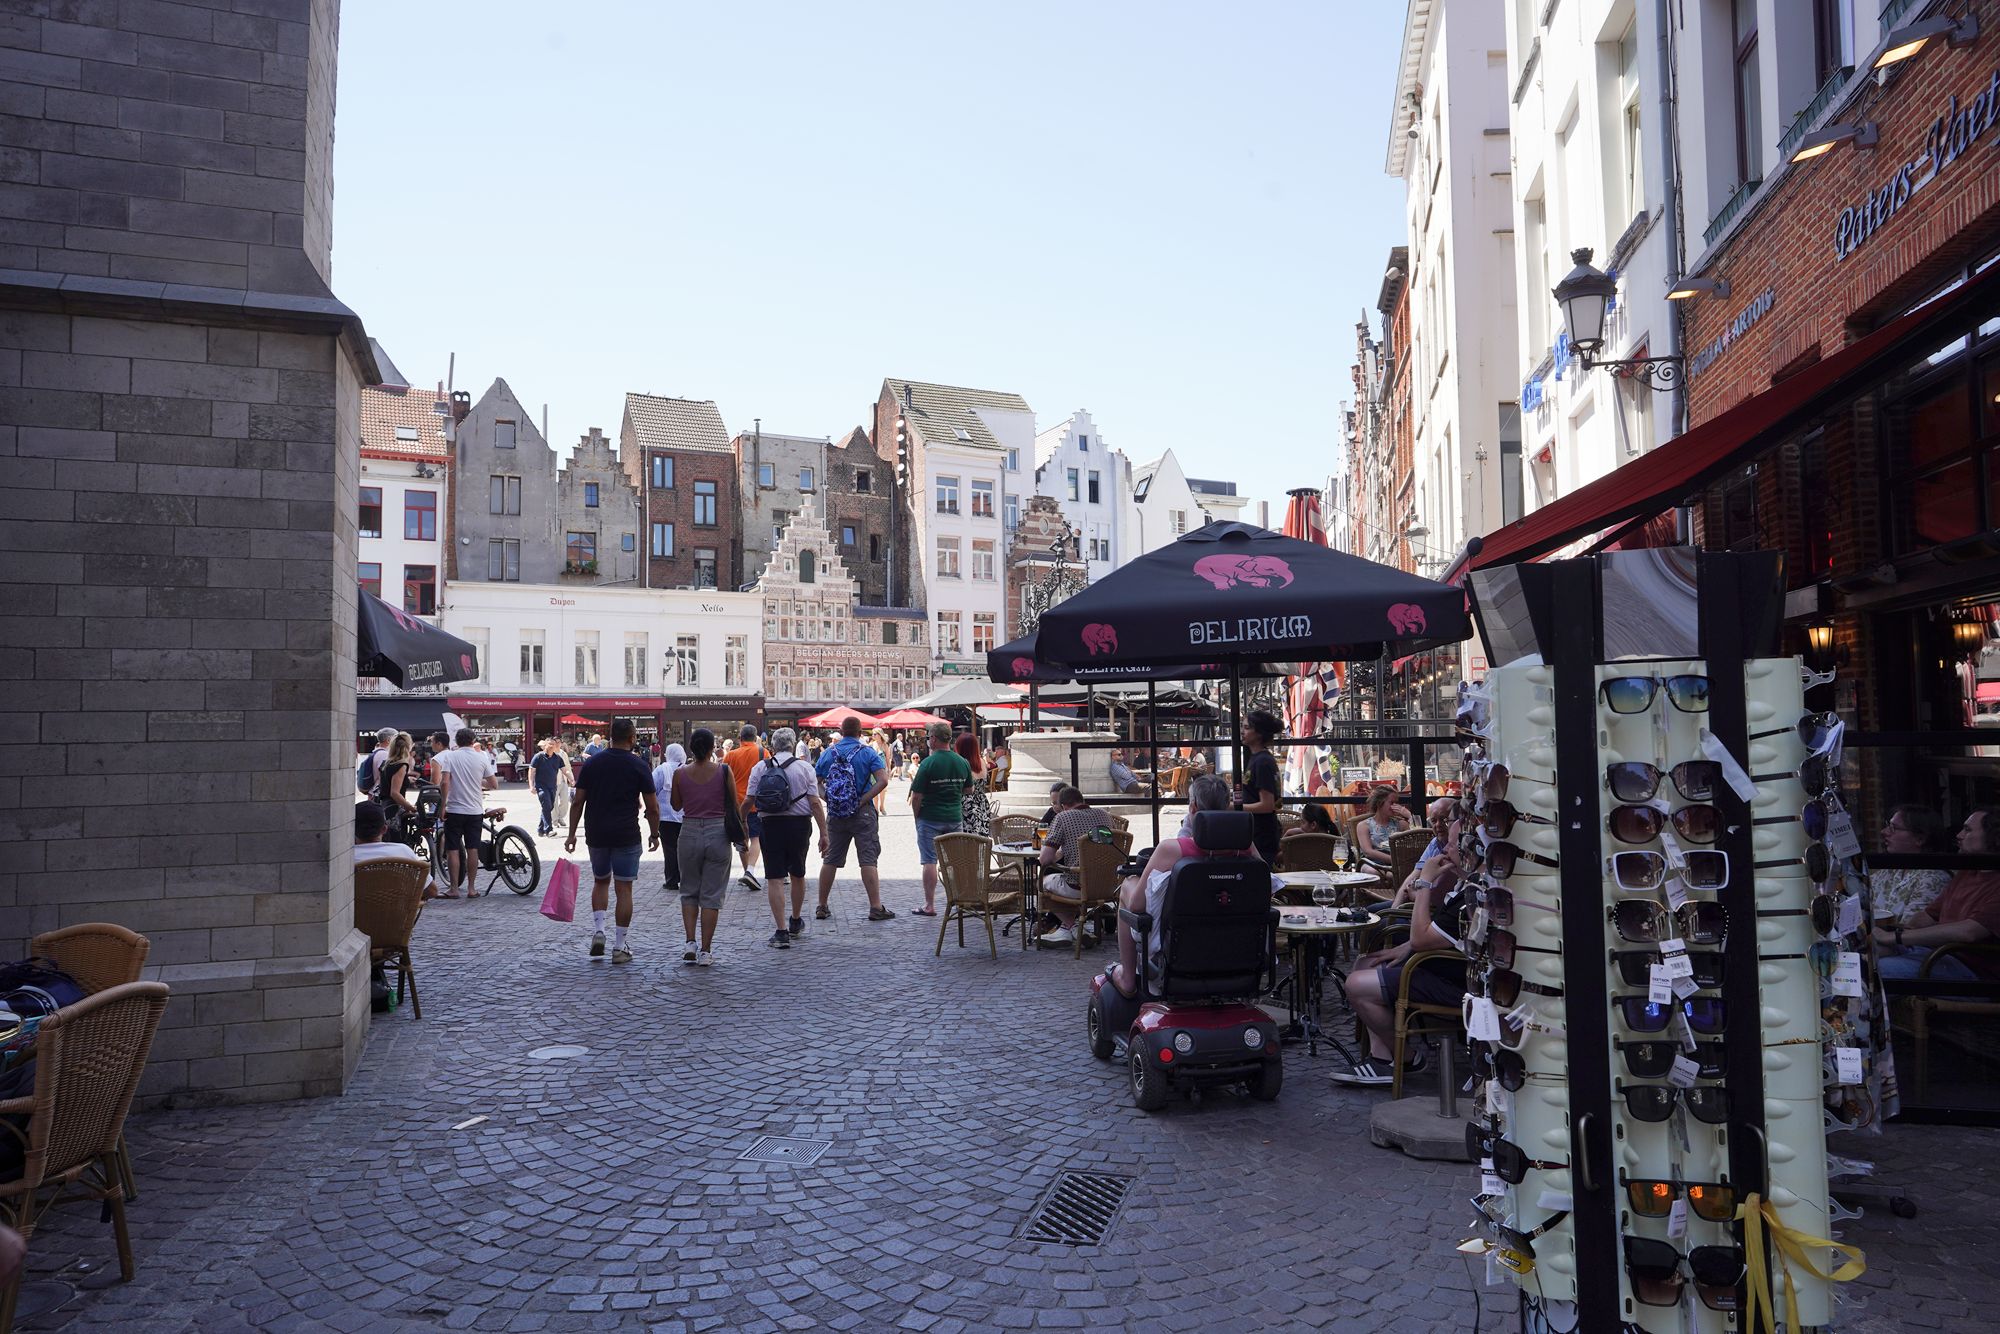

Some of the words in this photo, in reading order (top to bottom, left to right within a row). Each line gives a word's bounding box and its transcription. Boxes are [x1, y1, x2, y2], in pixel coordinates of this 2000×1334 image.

[1835, 162, 1914, 263] Paters
[1731, 286, 1775, 341] ARTOIS
[1188, 615, 1313, 645] DELIRIUM
[796, 649, 834, 657] BELGIAN
[836, 650, 862, 658] BEERS
[872, 651, 900, 659] BREWS
